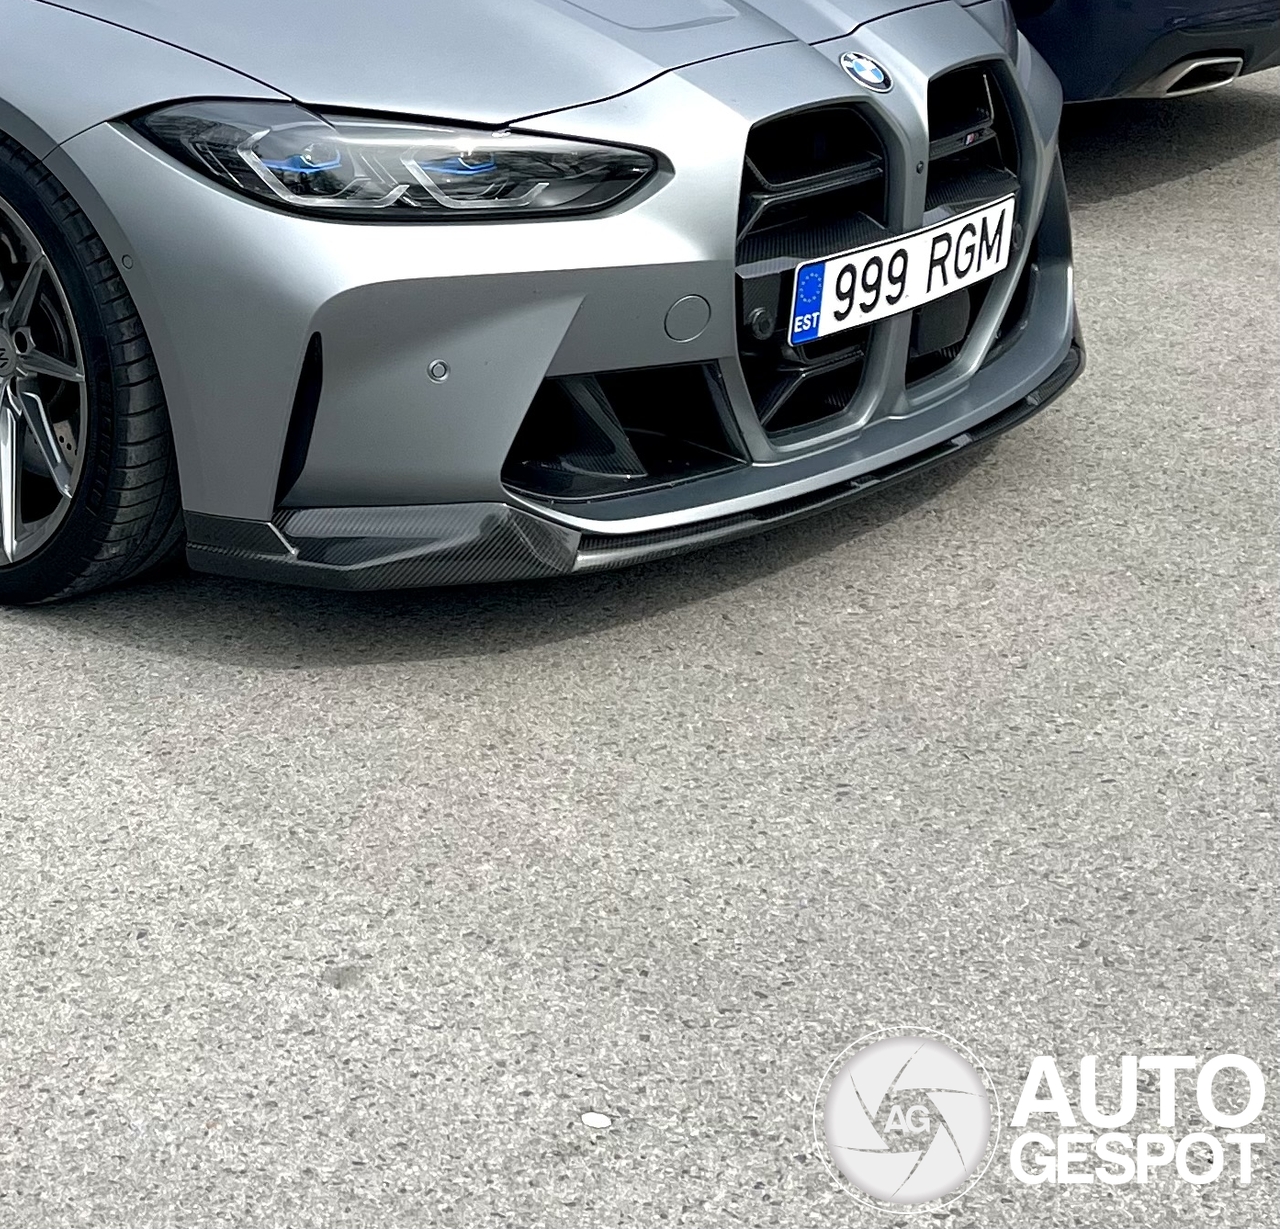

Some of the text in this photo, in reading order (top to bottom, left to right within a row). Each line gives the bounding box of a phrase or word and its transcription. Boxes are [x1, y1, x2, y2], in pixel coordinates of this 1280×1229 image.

[794, 208, 1006, 333] EST 999 RGM
